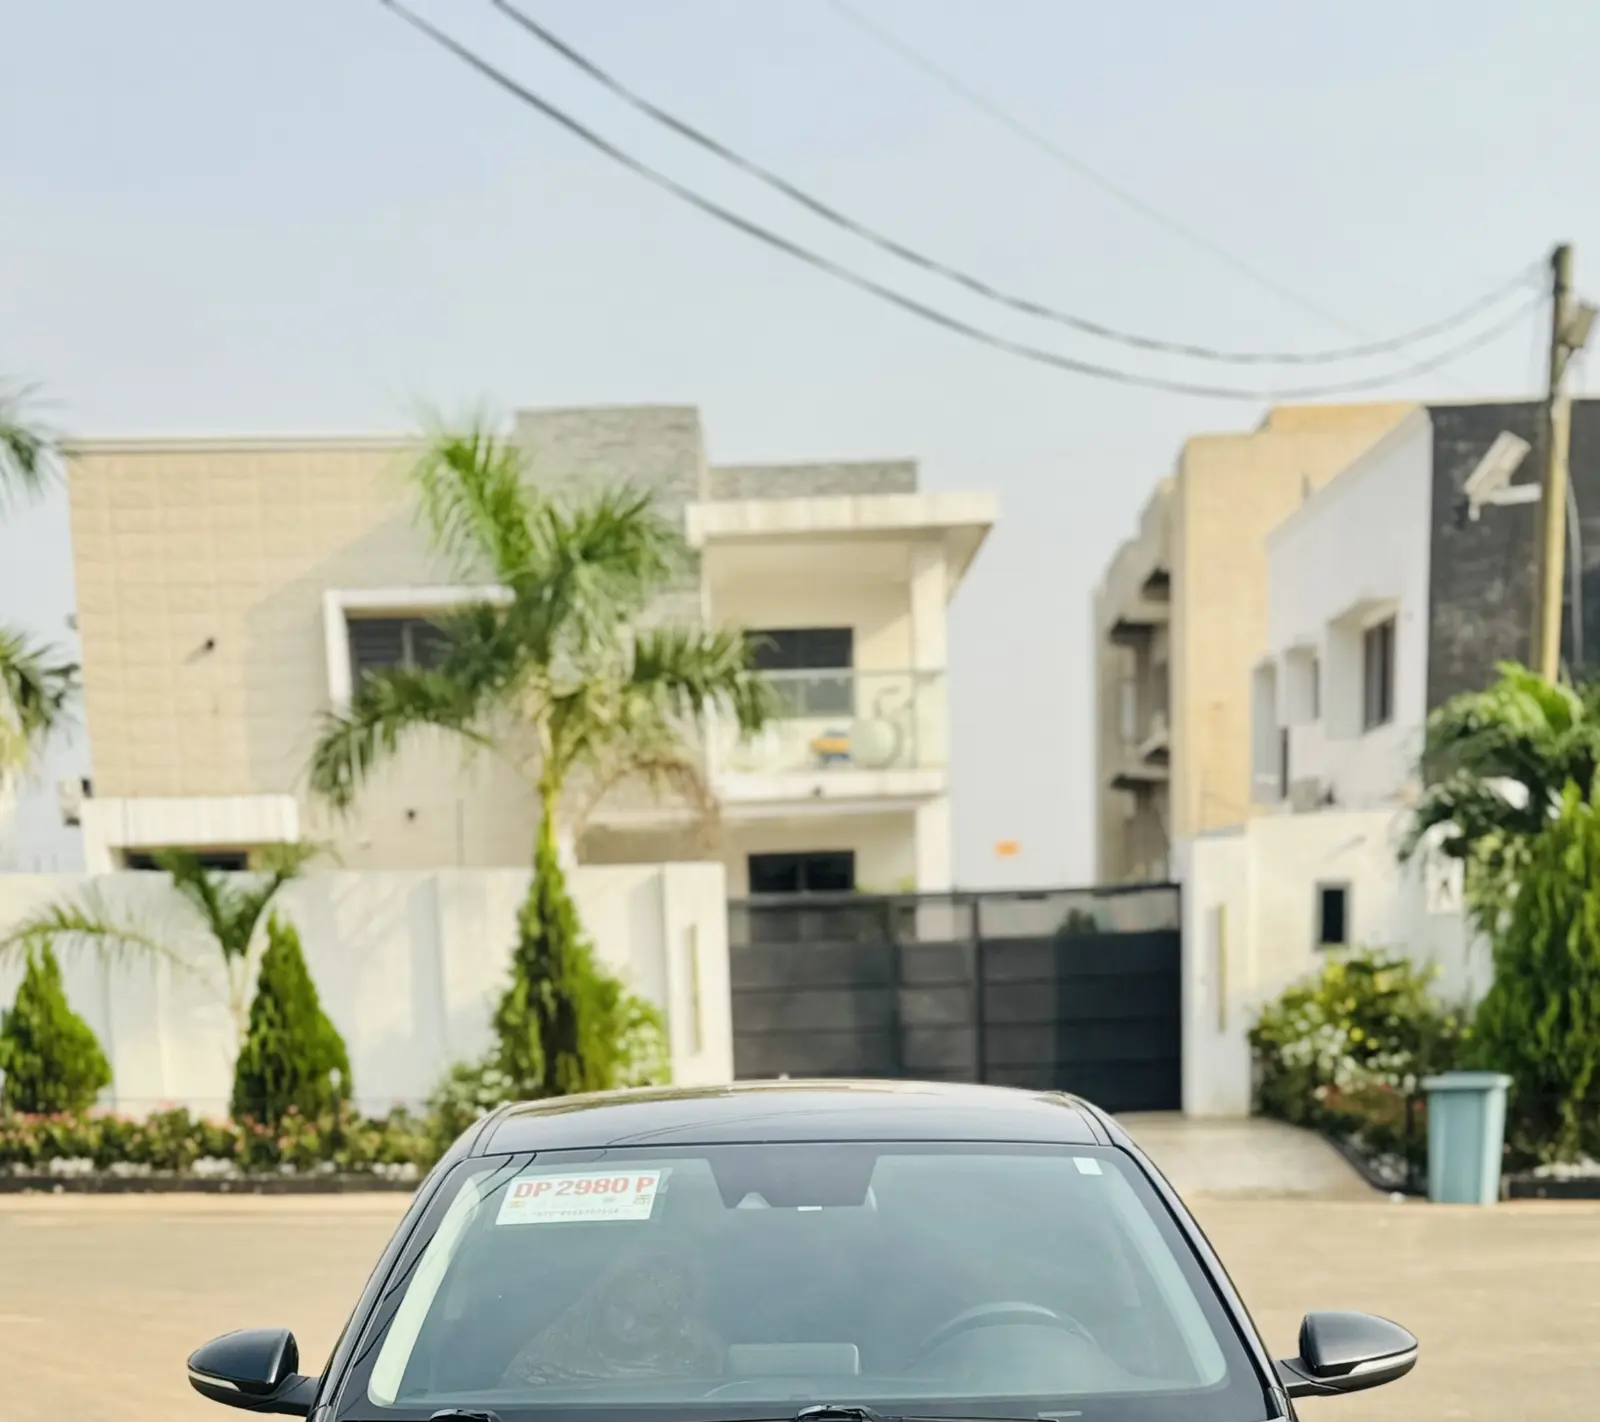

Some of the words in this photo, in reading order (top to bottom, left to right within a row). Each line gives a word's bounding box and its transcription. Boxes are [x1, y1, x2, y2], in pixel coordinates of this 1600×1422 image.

[513, 1181, 552, 1198] DP
[555, 1177, 629, 1197] 2980
[635, 1176, 655, 1194] P
